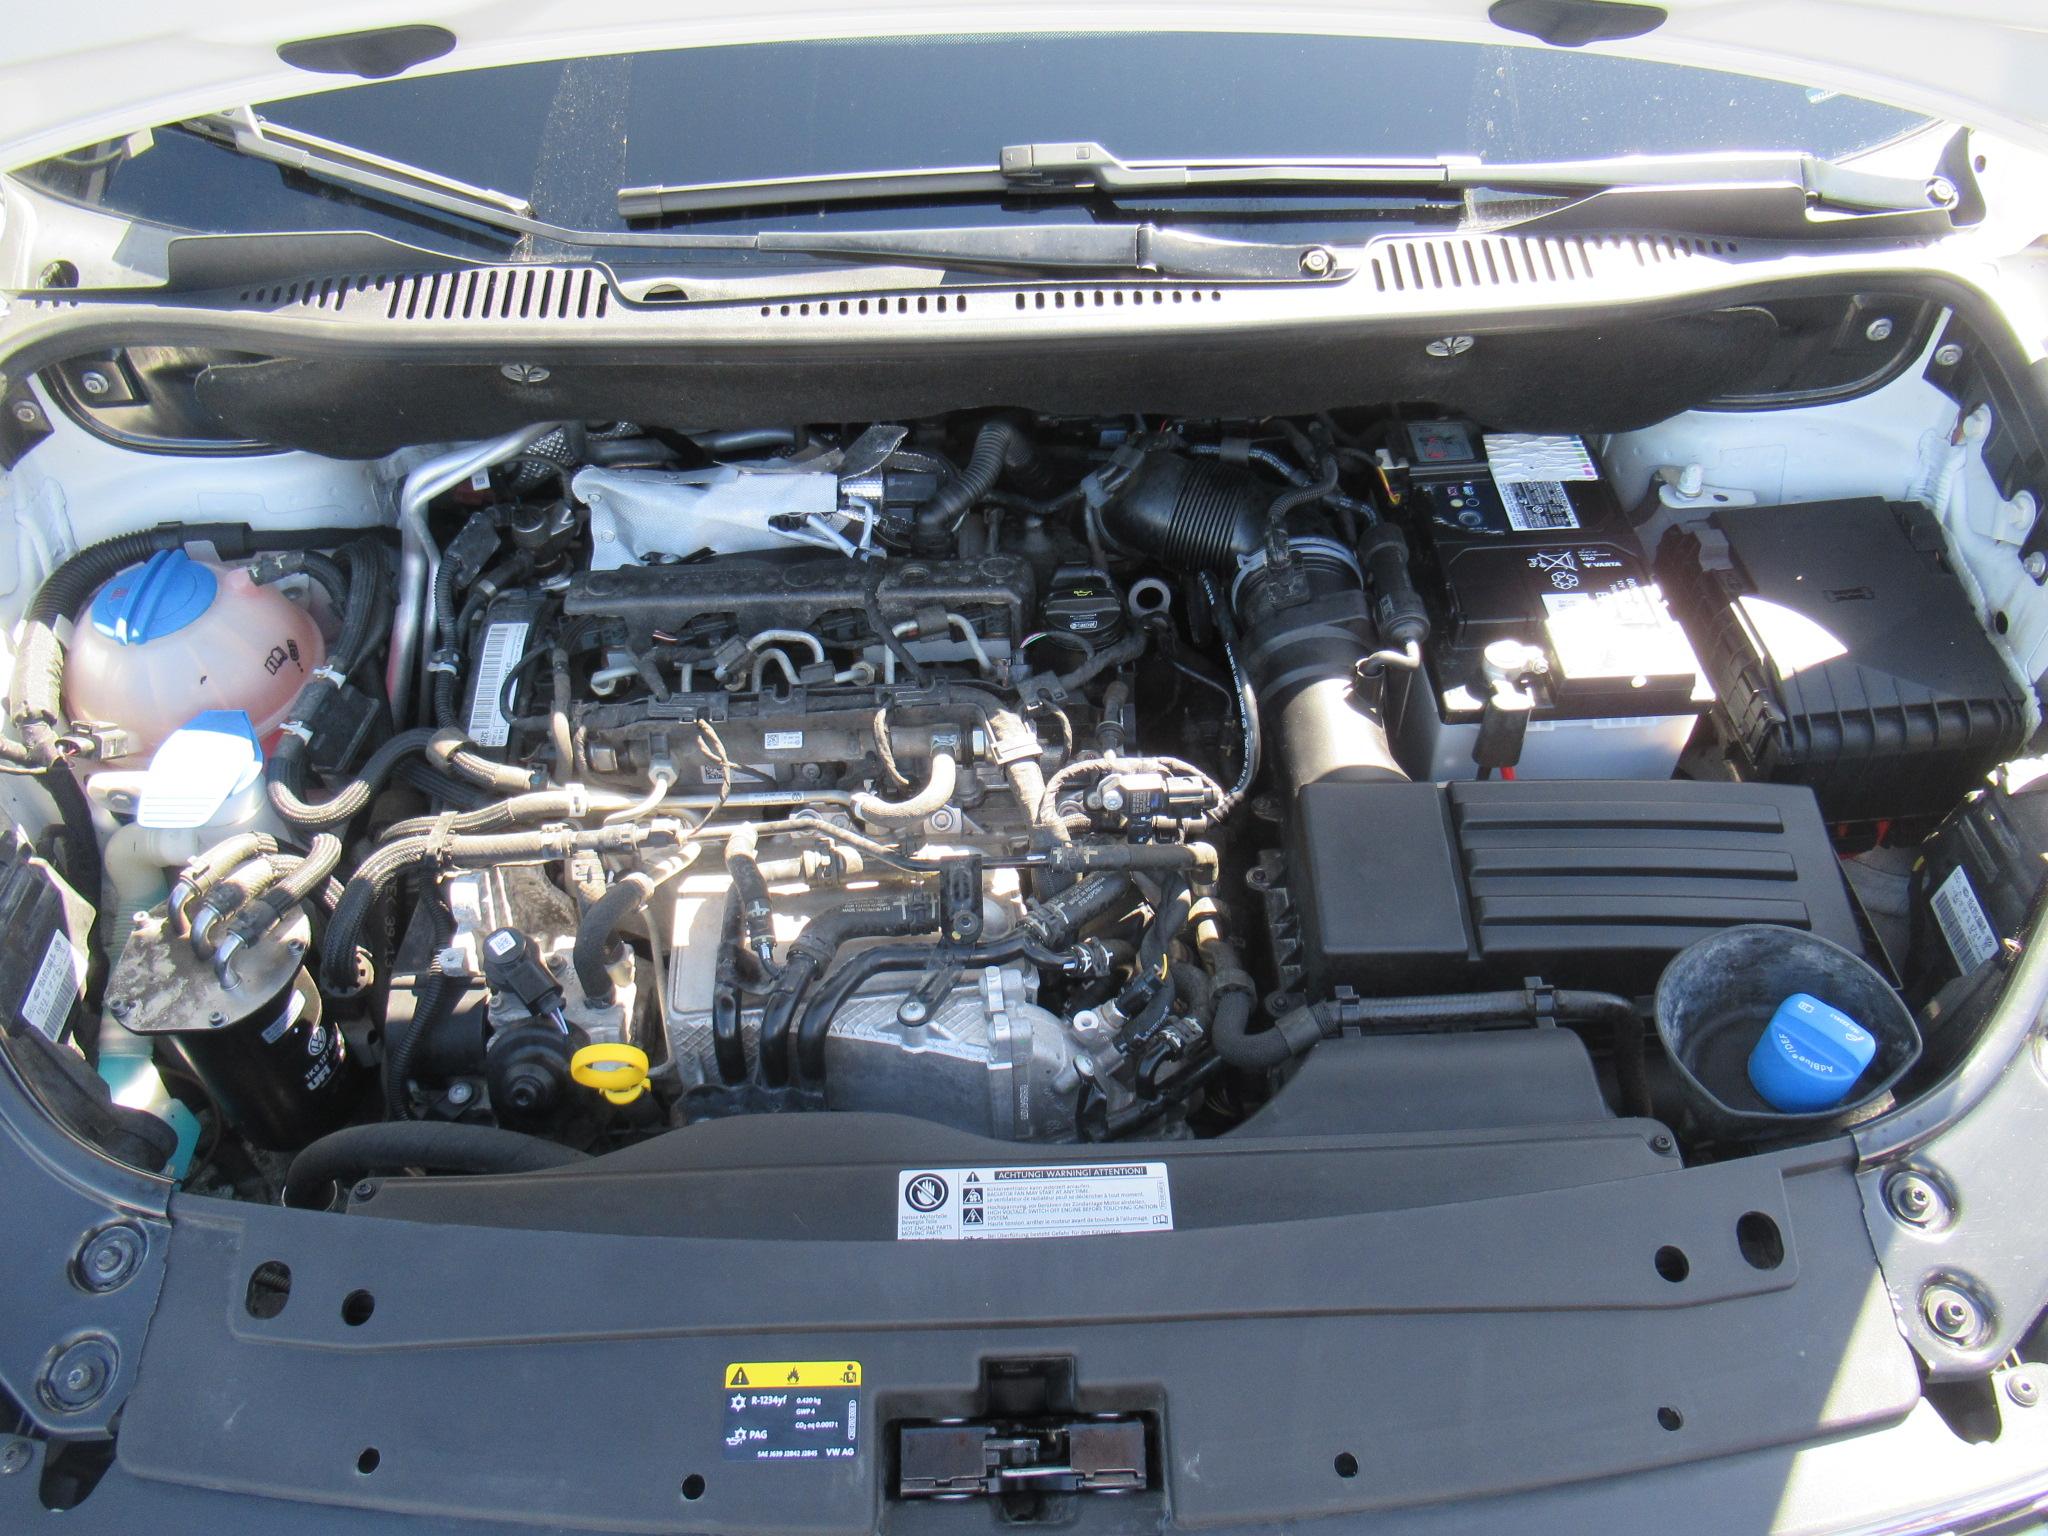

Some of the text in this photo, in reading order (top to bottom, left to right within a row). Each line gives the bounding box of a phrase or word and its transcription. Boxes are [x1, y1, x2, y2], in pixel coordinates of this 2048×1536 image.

[307, 1065, 331, 1091] UFI
[998, 1167, 1144, 1179] ACHTUNG! WARNING! ATTENTION!
[751, 1394, 788, 1407] R-1234yf
[814, 1396, 822, 1406] kg
[796, 1408, 811, 1416] GWP
[750, 1430, 768, 1440] PAG
[758, 1450, 768, 1458] SAE
[826, 1448, 855, 1457] VW AG
